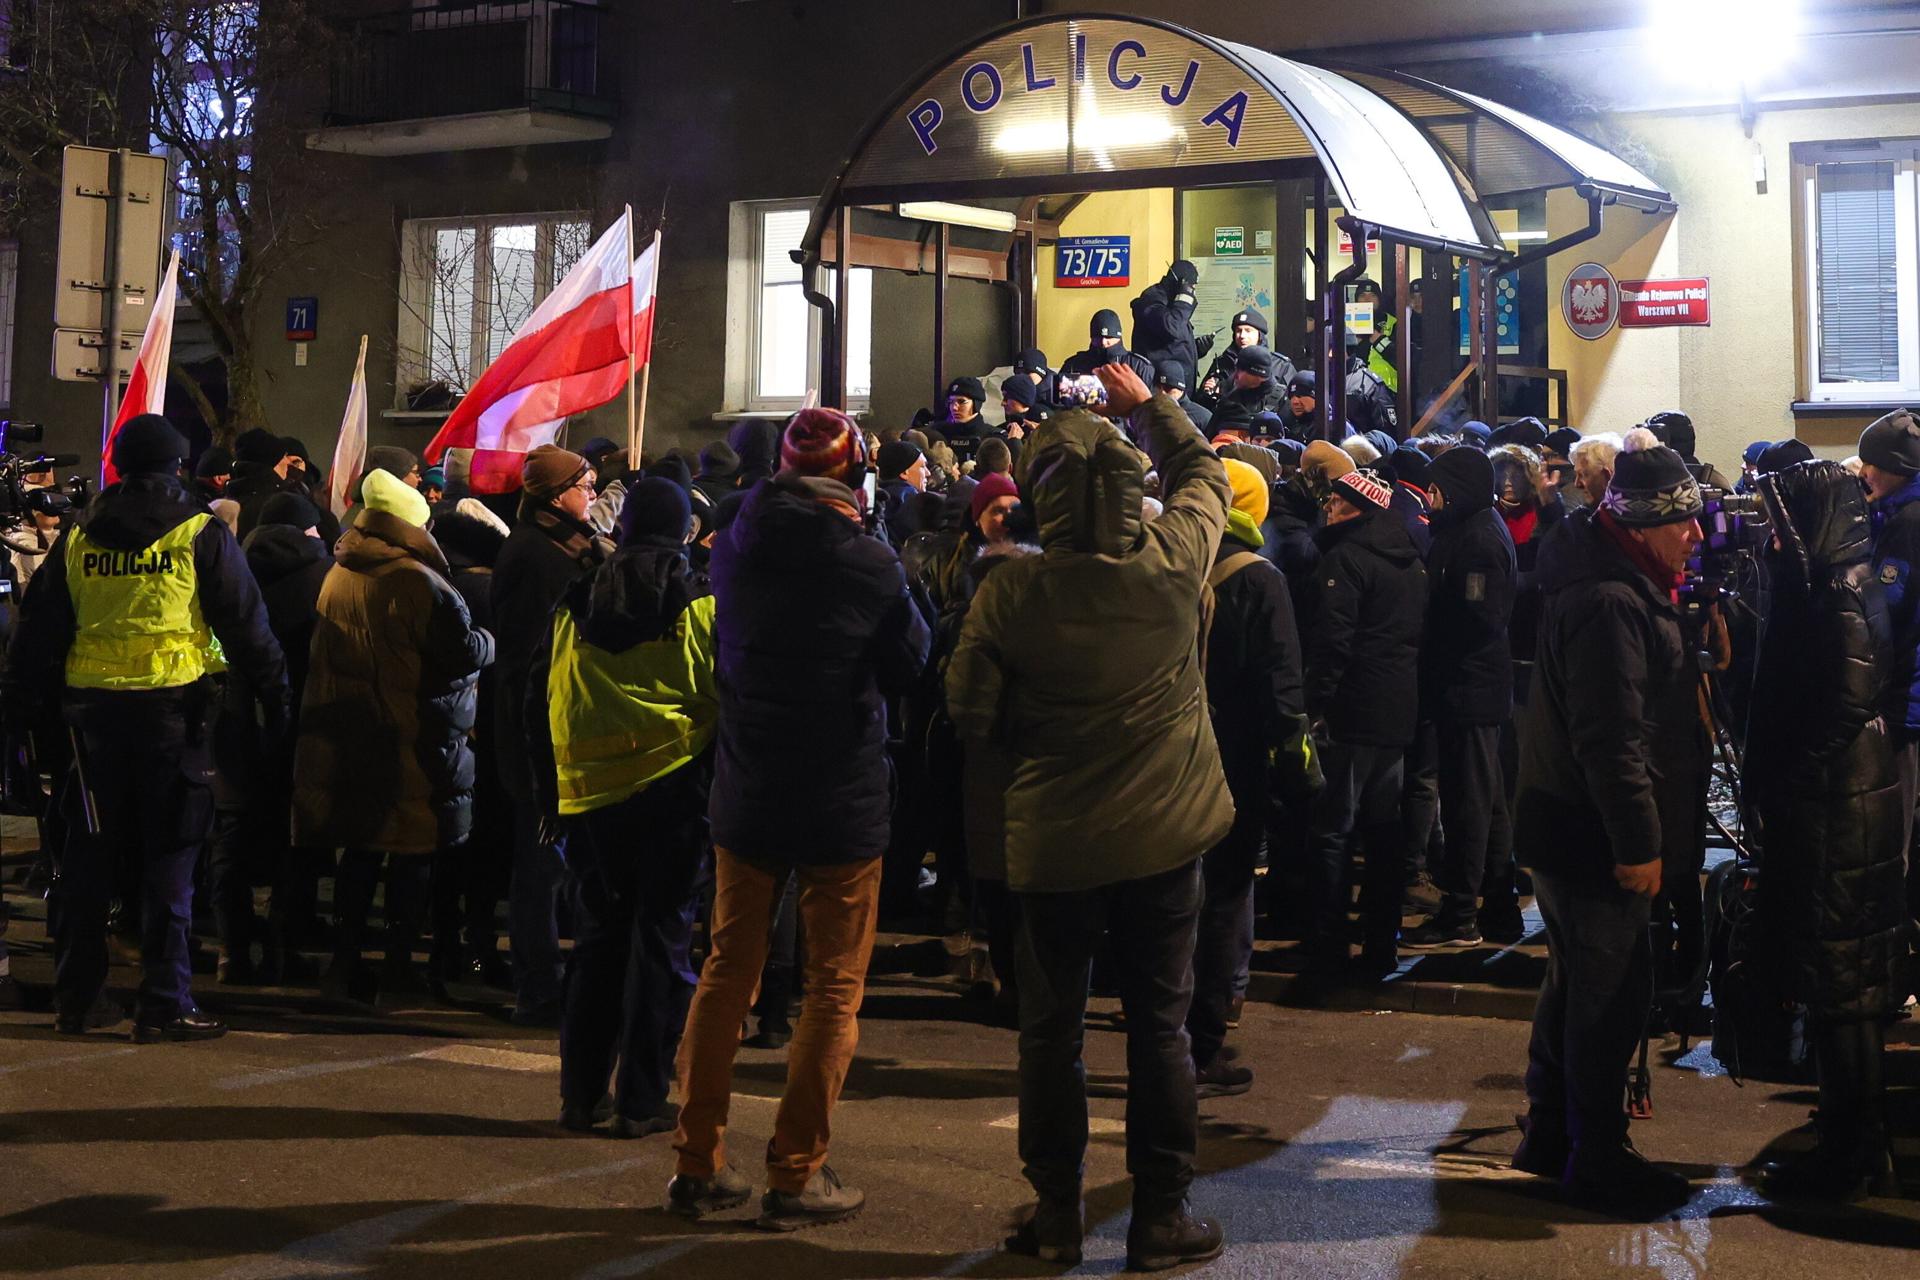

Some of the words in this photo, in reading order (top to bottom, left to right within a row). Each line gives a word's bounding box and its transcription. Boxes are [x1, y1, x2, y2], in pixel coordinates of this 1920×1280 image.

[907, 33, 1249, 156] POLICJA
[1225, 240, 1242, 249] AED
[1063, 248, 1122, 278] 73/75
[1650, 289, 1683, 302] Rejonowa
[1685, 288, 1706, 300] Policji
[293, 307, 307, 329] 71
[1637, 305, 1676, 316] Warszawa
[1677, 303, 1689, 315] VII
[83, 550, 173, 577] POLICJA
